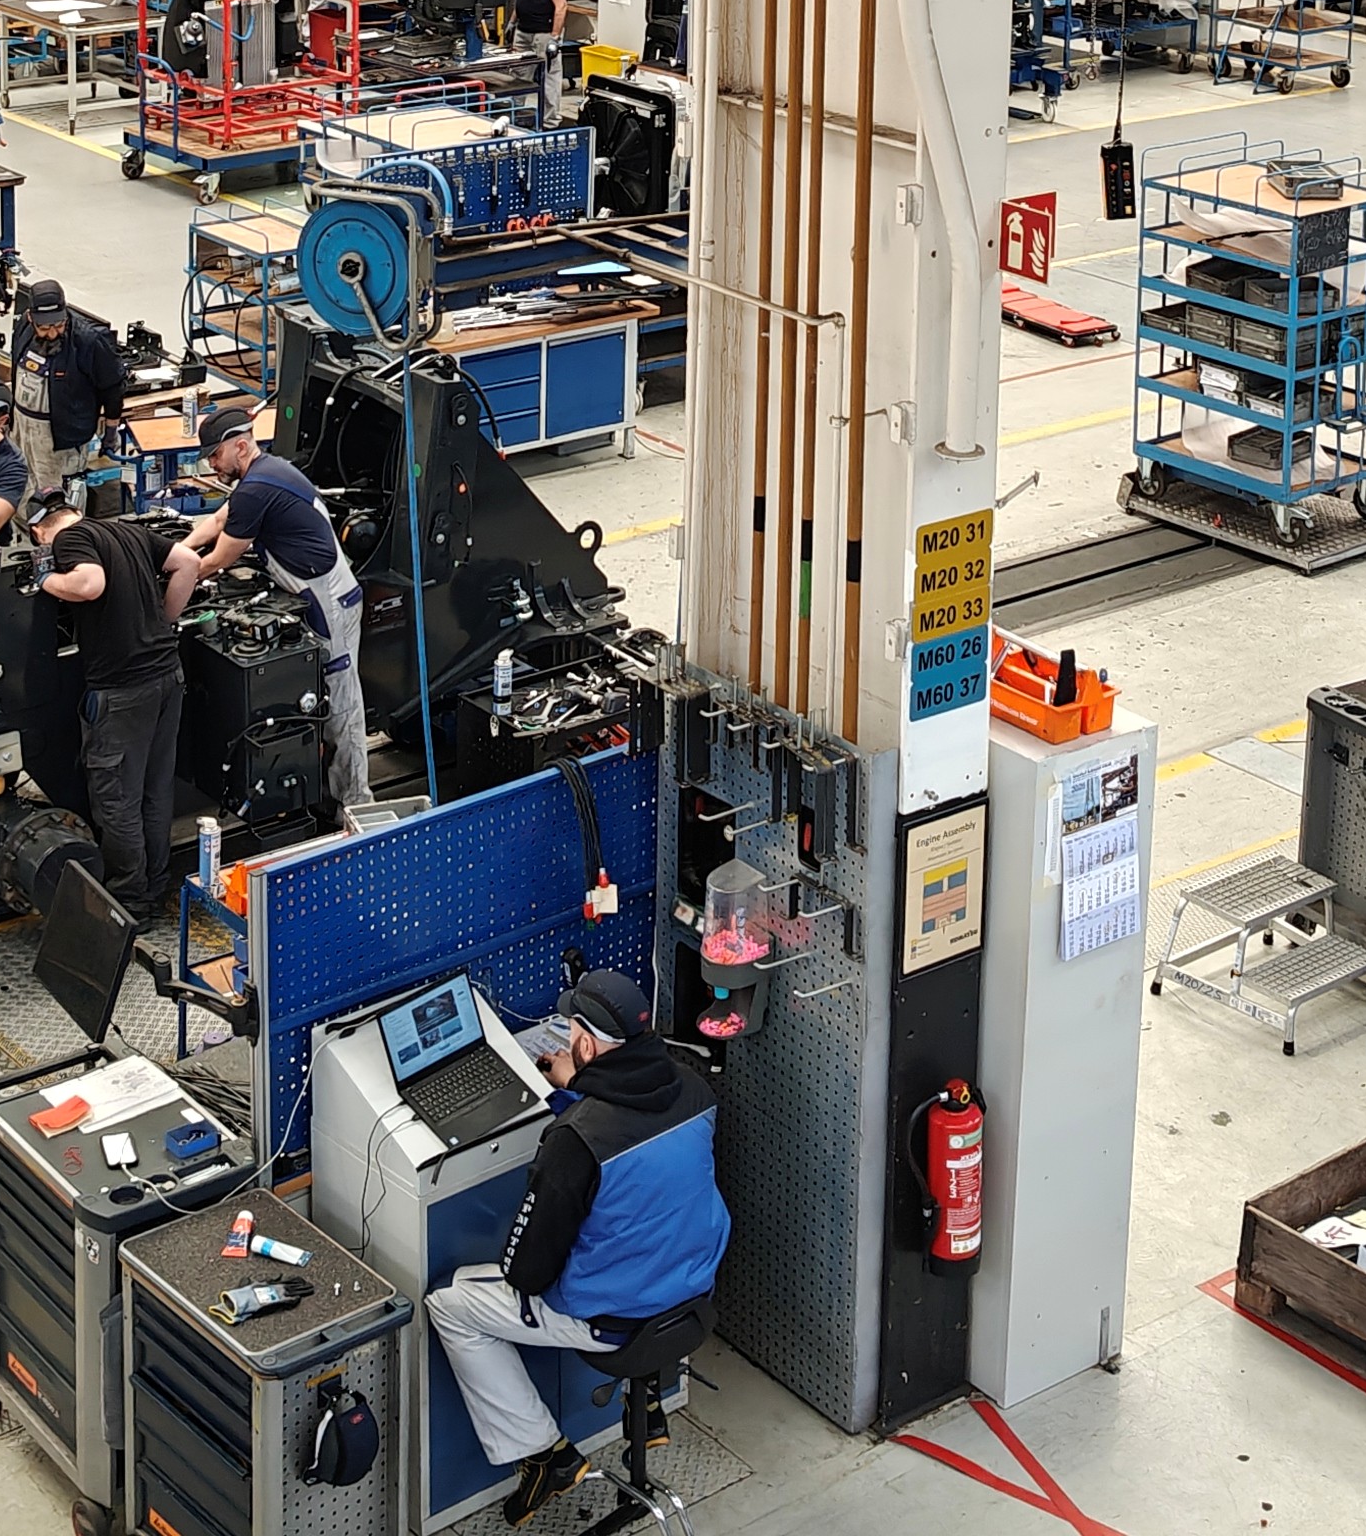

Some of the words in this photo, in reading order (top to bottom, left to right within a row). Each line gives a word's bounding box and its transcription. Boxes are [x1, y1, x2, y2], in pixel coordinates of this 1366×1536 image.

[922, 528, 960, 554] M20
[964, 519, 986, 544] 31
[921, 567, 959, 594] M20
[963, 558, 985, 584] 32
[920, 607, 958, 634] M20
[962, 599, 984, 624] 33
[918, 645, 957, 673] M60
[961, 636, 983, 661] 26
[916, 681, 956, 708] M60
[960, 673, 982, 698] 37
[916, 834, 942, 849] Engine
[942, 821, 977, 842] Assembly
